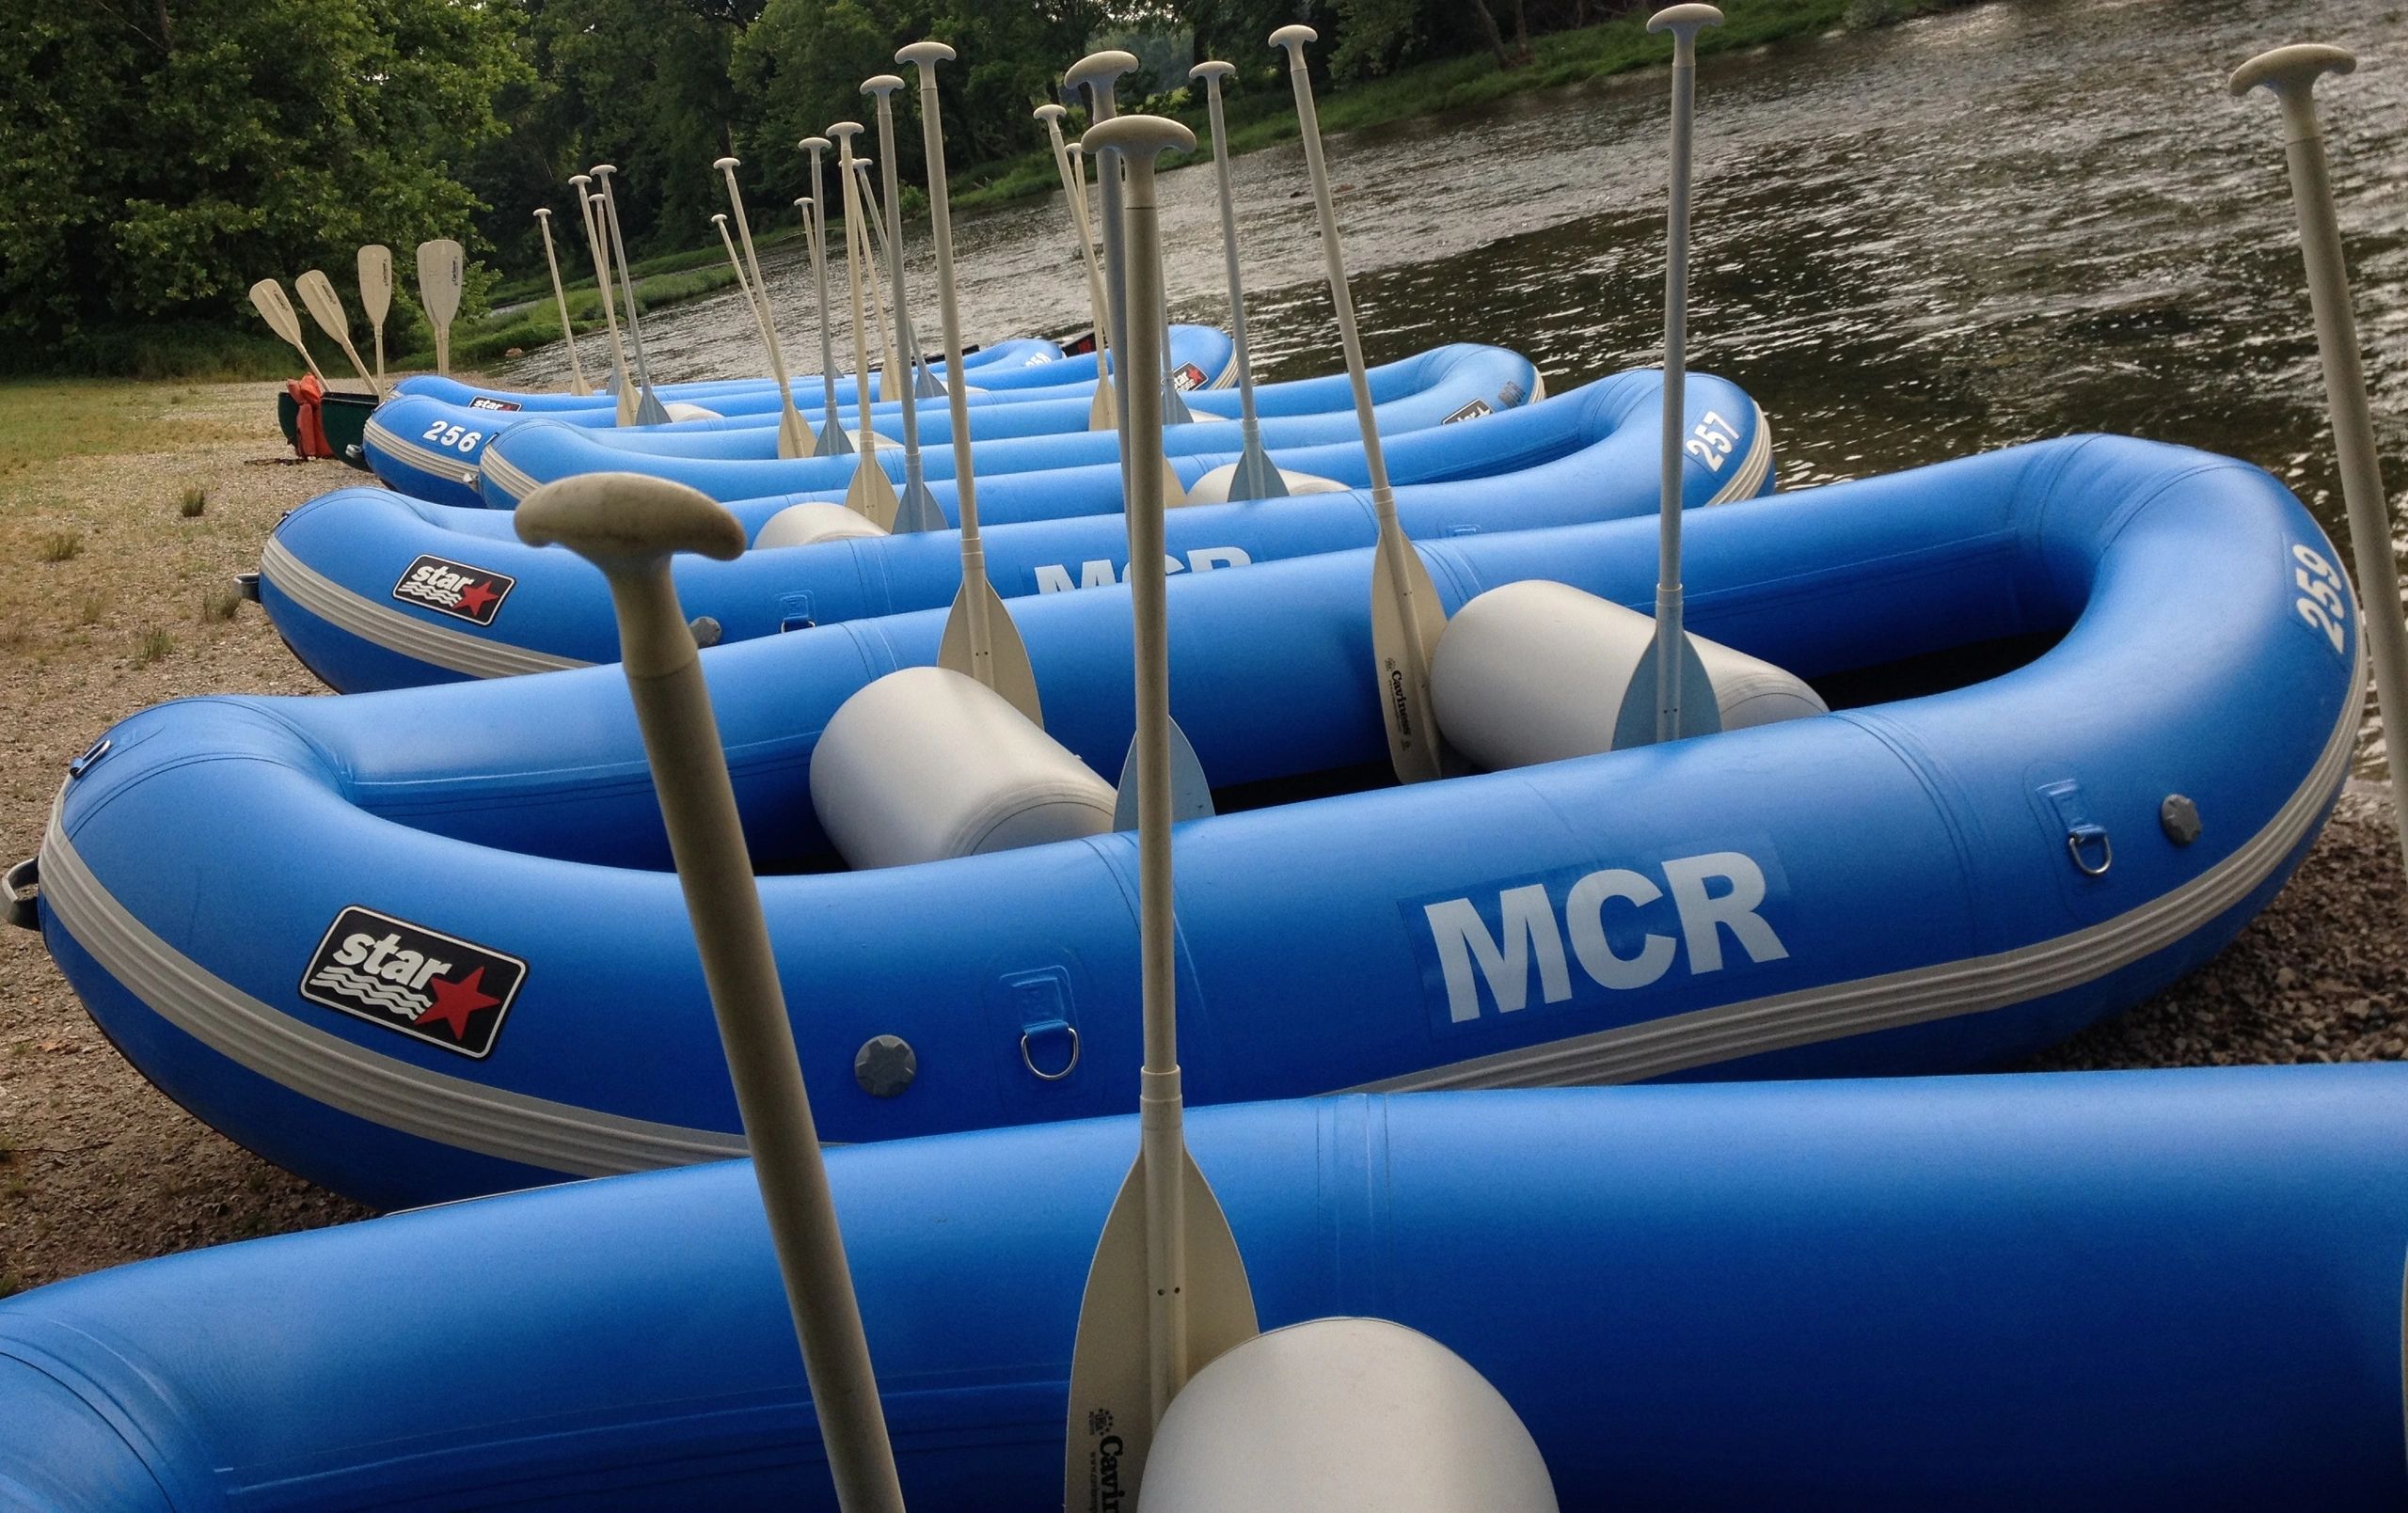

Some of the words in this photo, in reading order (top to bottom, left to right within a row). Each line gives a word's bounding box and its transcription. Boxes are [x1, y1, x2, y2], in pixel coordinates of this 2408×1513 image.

[473, 400, 503, 411] star
[422, 420, 482, 452] 256
[1686, 411, 1740, 472] 257
[411, 566, 474, 592] star
[2292, 544, 2344, 654] 259
[1392, 670, 1411, 735] Caviness
[332, 933, 452, 990] star
[1423, 851, 1790, 1023] MCR
